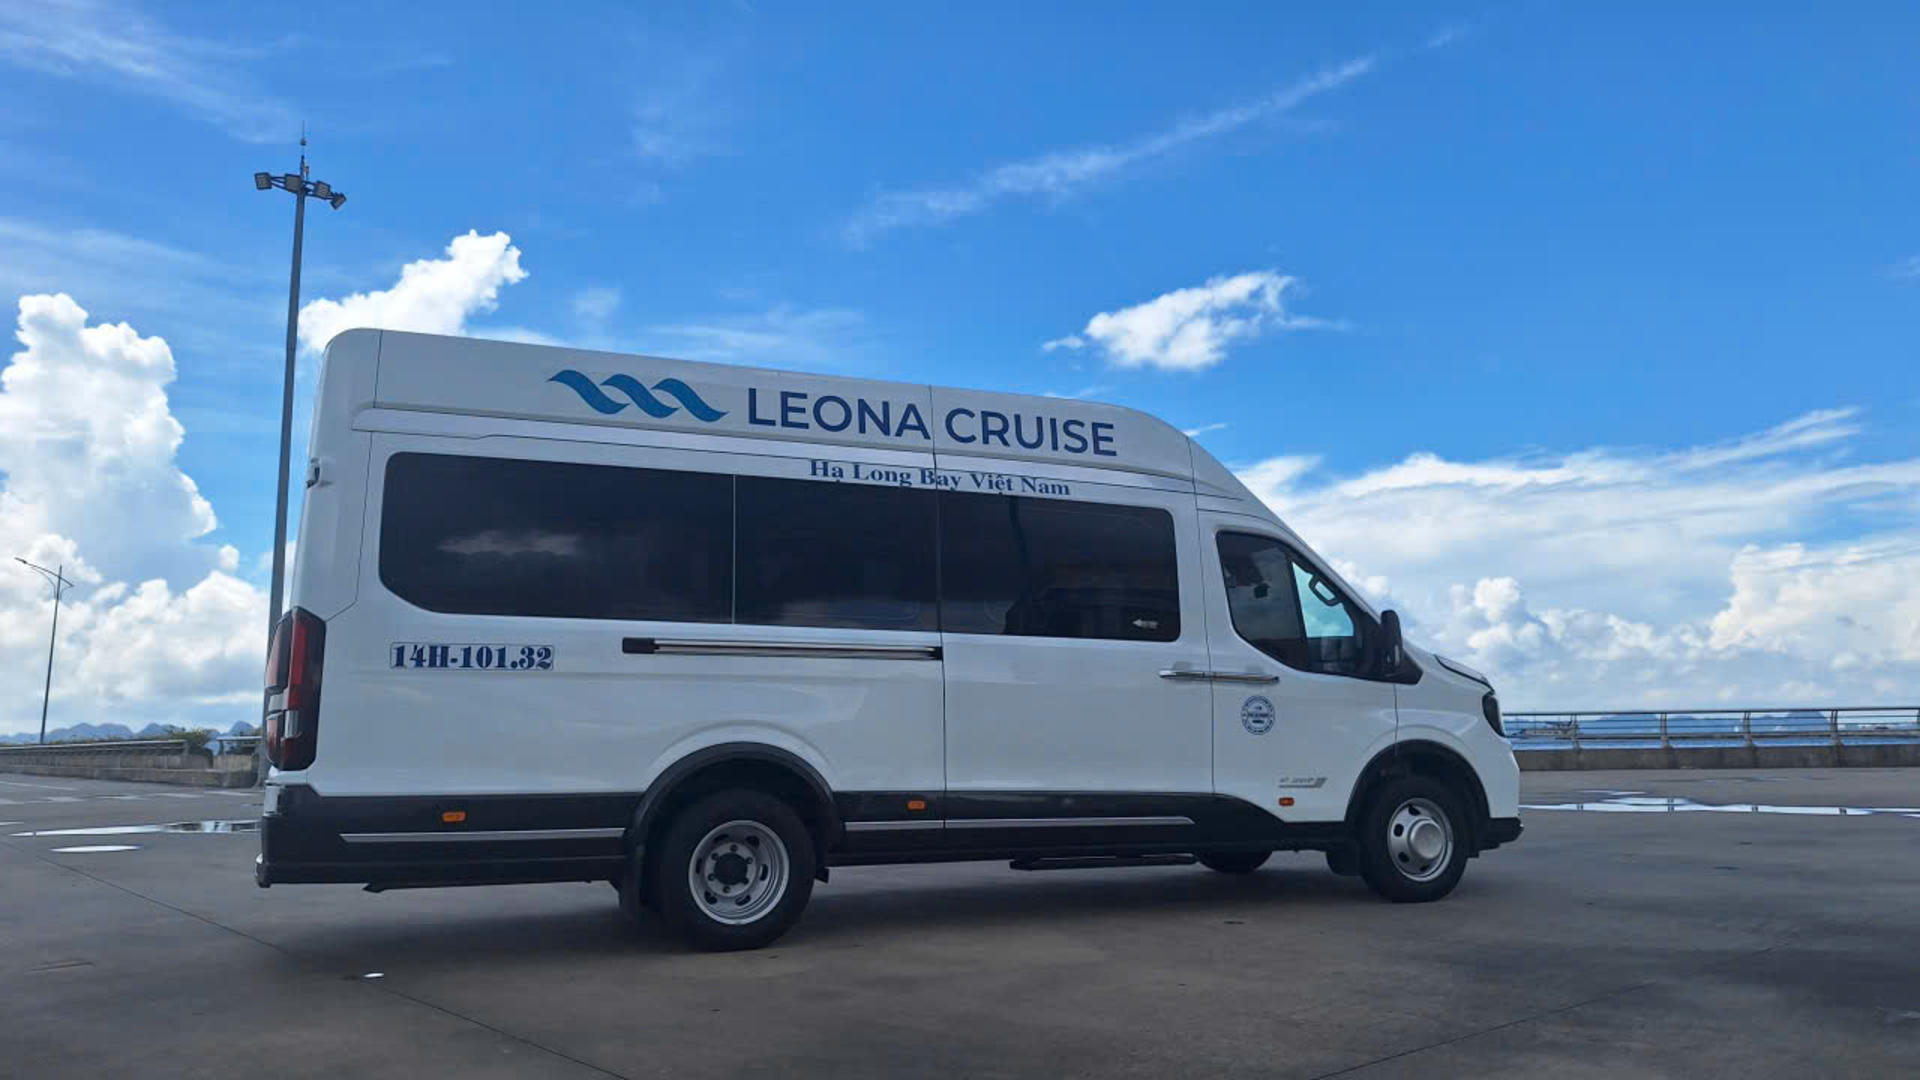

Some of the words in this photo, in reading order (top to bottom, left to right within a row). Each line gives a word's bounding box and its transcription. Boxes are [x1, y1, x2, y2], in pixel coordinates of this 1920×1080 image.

[748, 387, 932, 441] LEONA
[945, 408, 1118, 457] CRUISE
[853, 463, 913, 487] Long
[920, 467, 963, 492] Bay
[1020, 476, 1071, 496] Nam
[394, 644, 552, 670] 14H-101.32
